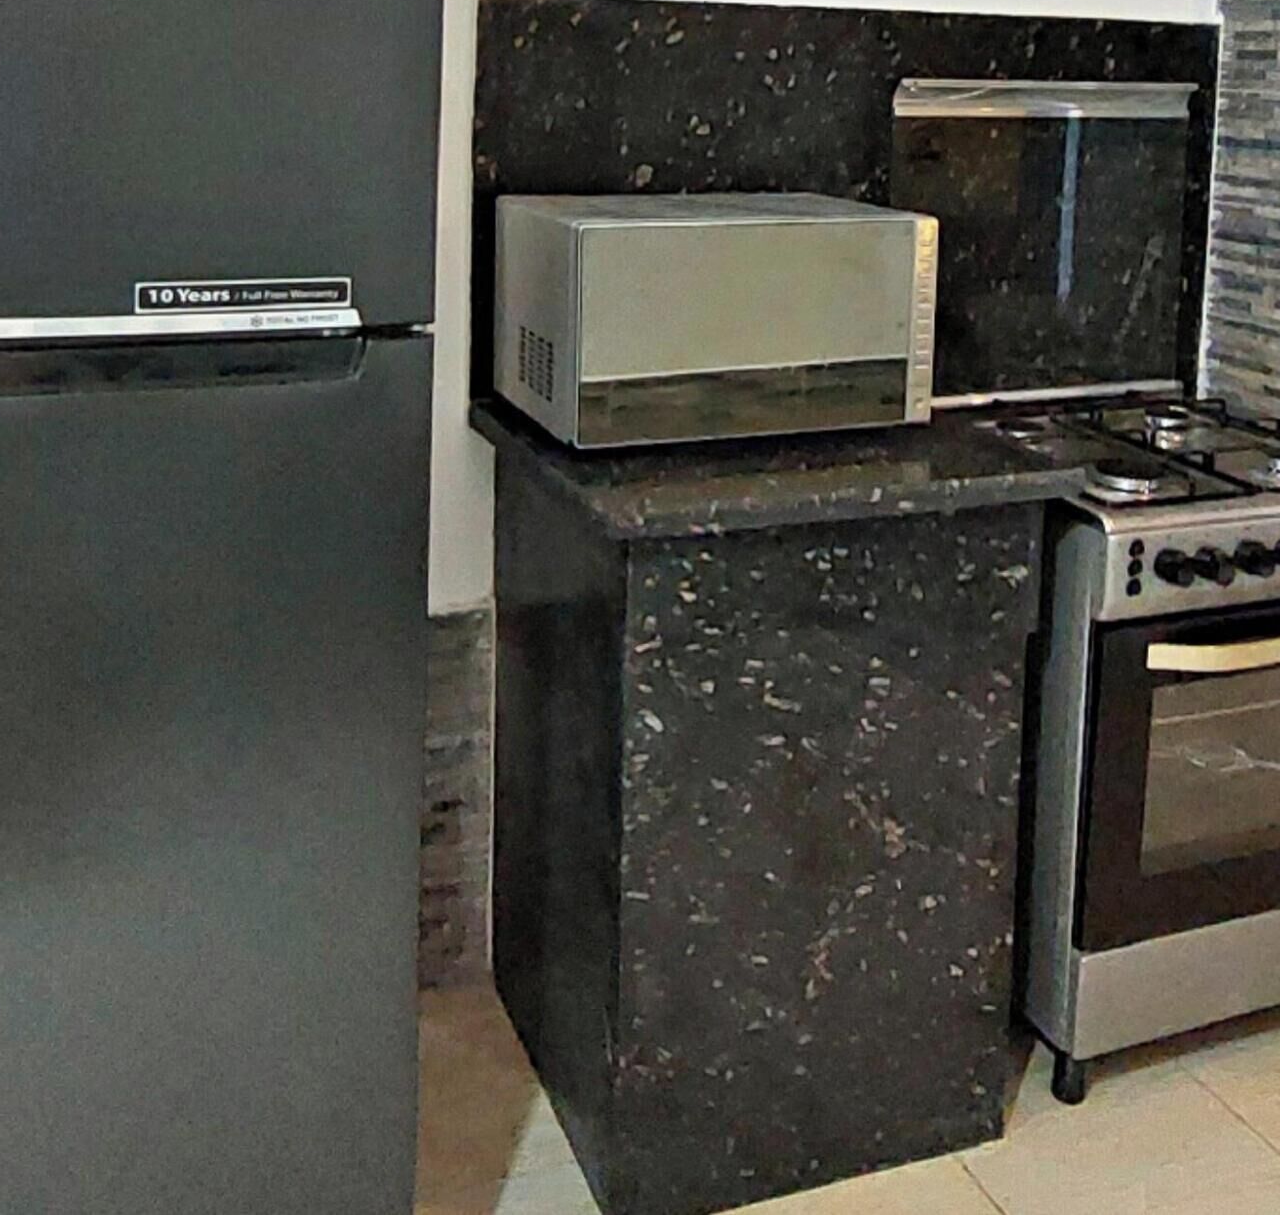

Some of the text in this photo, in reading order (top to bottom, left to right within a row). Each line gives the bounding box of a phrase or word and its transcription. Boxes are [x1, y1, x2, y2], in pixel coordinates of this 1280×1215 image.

[148, 289, 173, 304] 10
[176, 288, 230, 304] Years
[242, 289, 262, 301] Full
